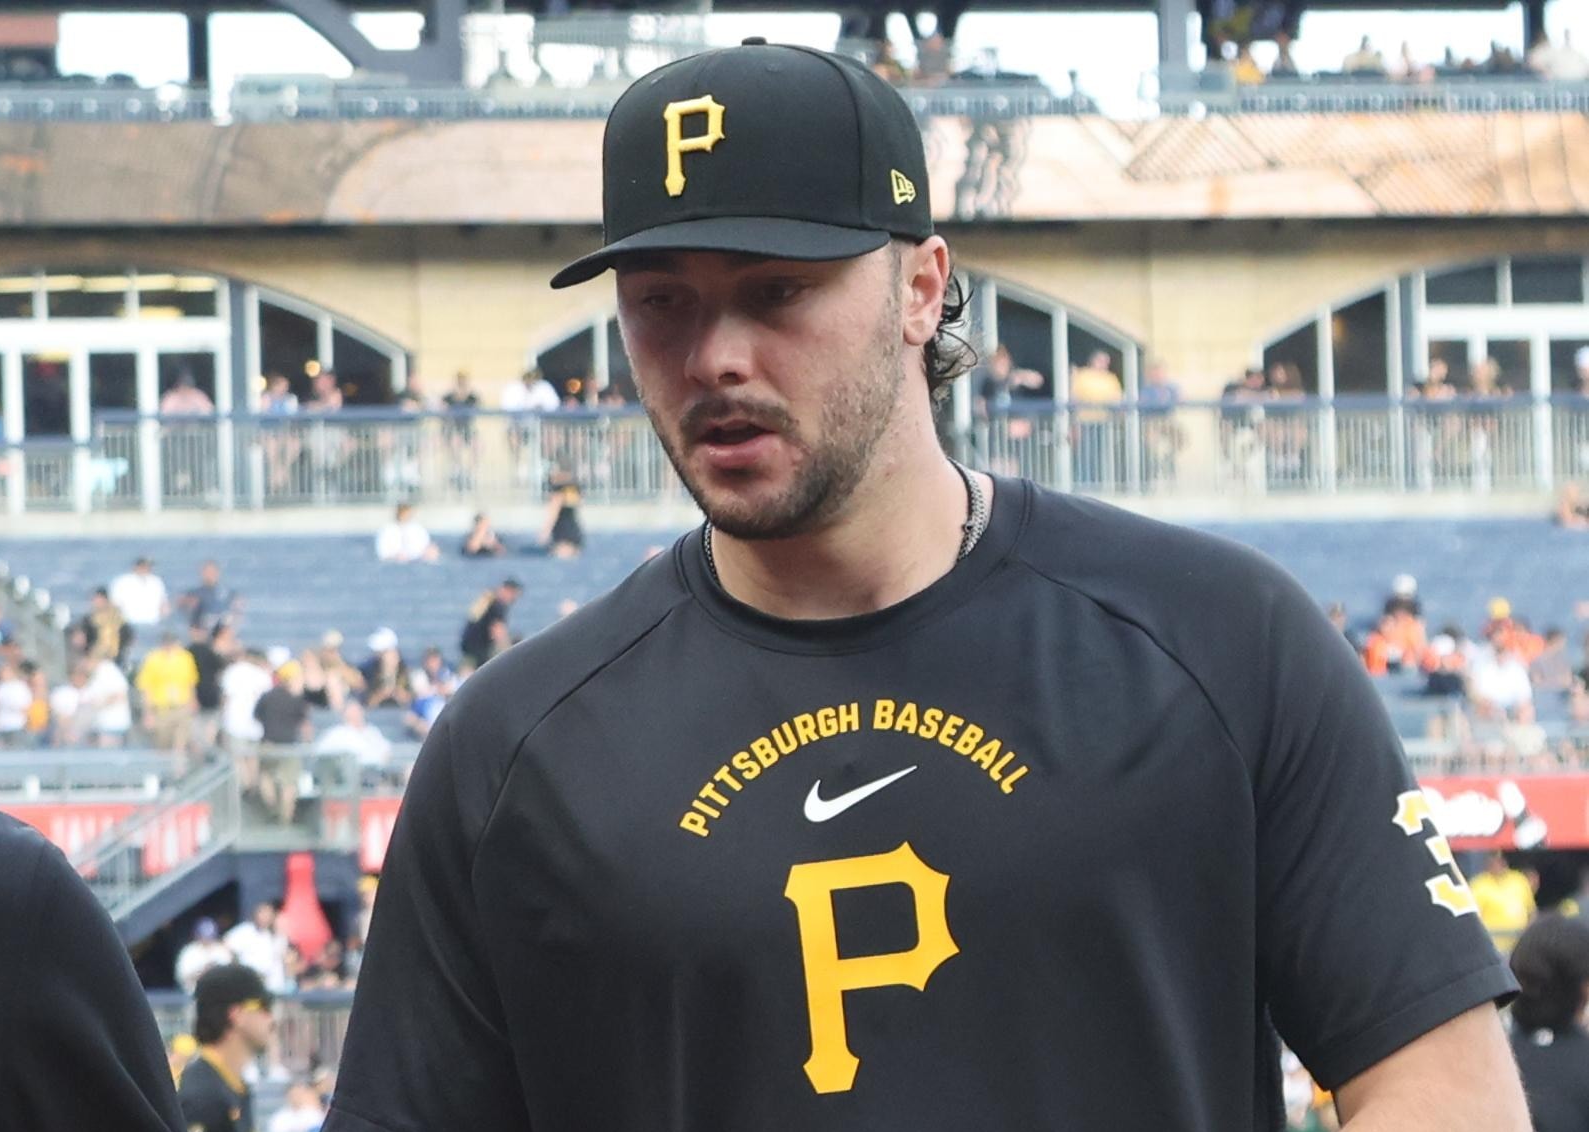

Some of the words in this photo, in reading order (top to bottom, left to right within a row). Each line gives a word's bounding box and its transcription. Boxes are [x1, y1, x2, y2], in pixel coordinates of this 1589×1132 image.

[663, 94, 726, 198] P
[679, 702, 860, 838] PITTSBURGH
[872, 698, 1030, 795] BASEBALL
[783, 840, 961, 1095] P
